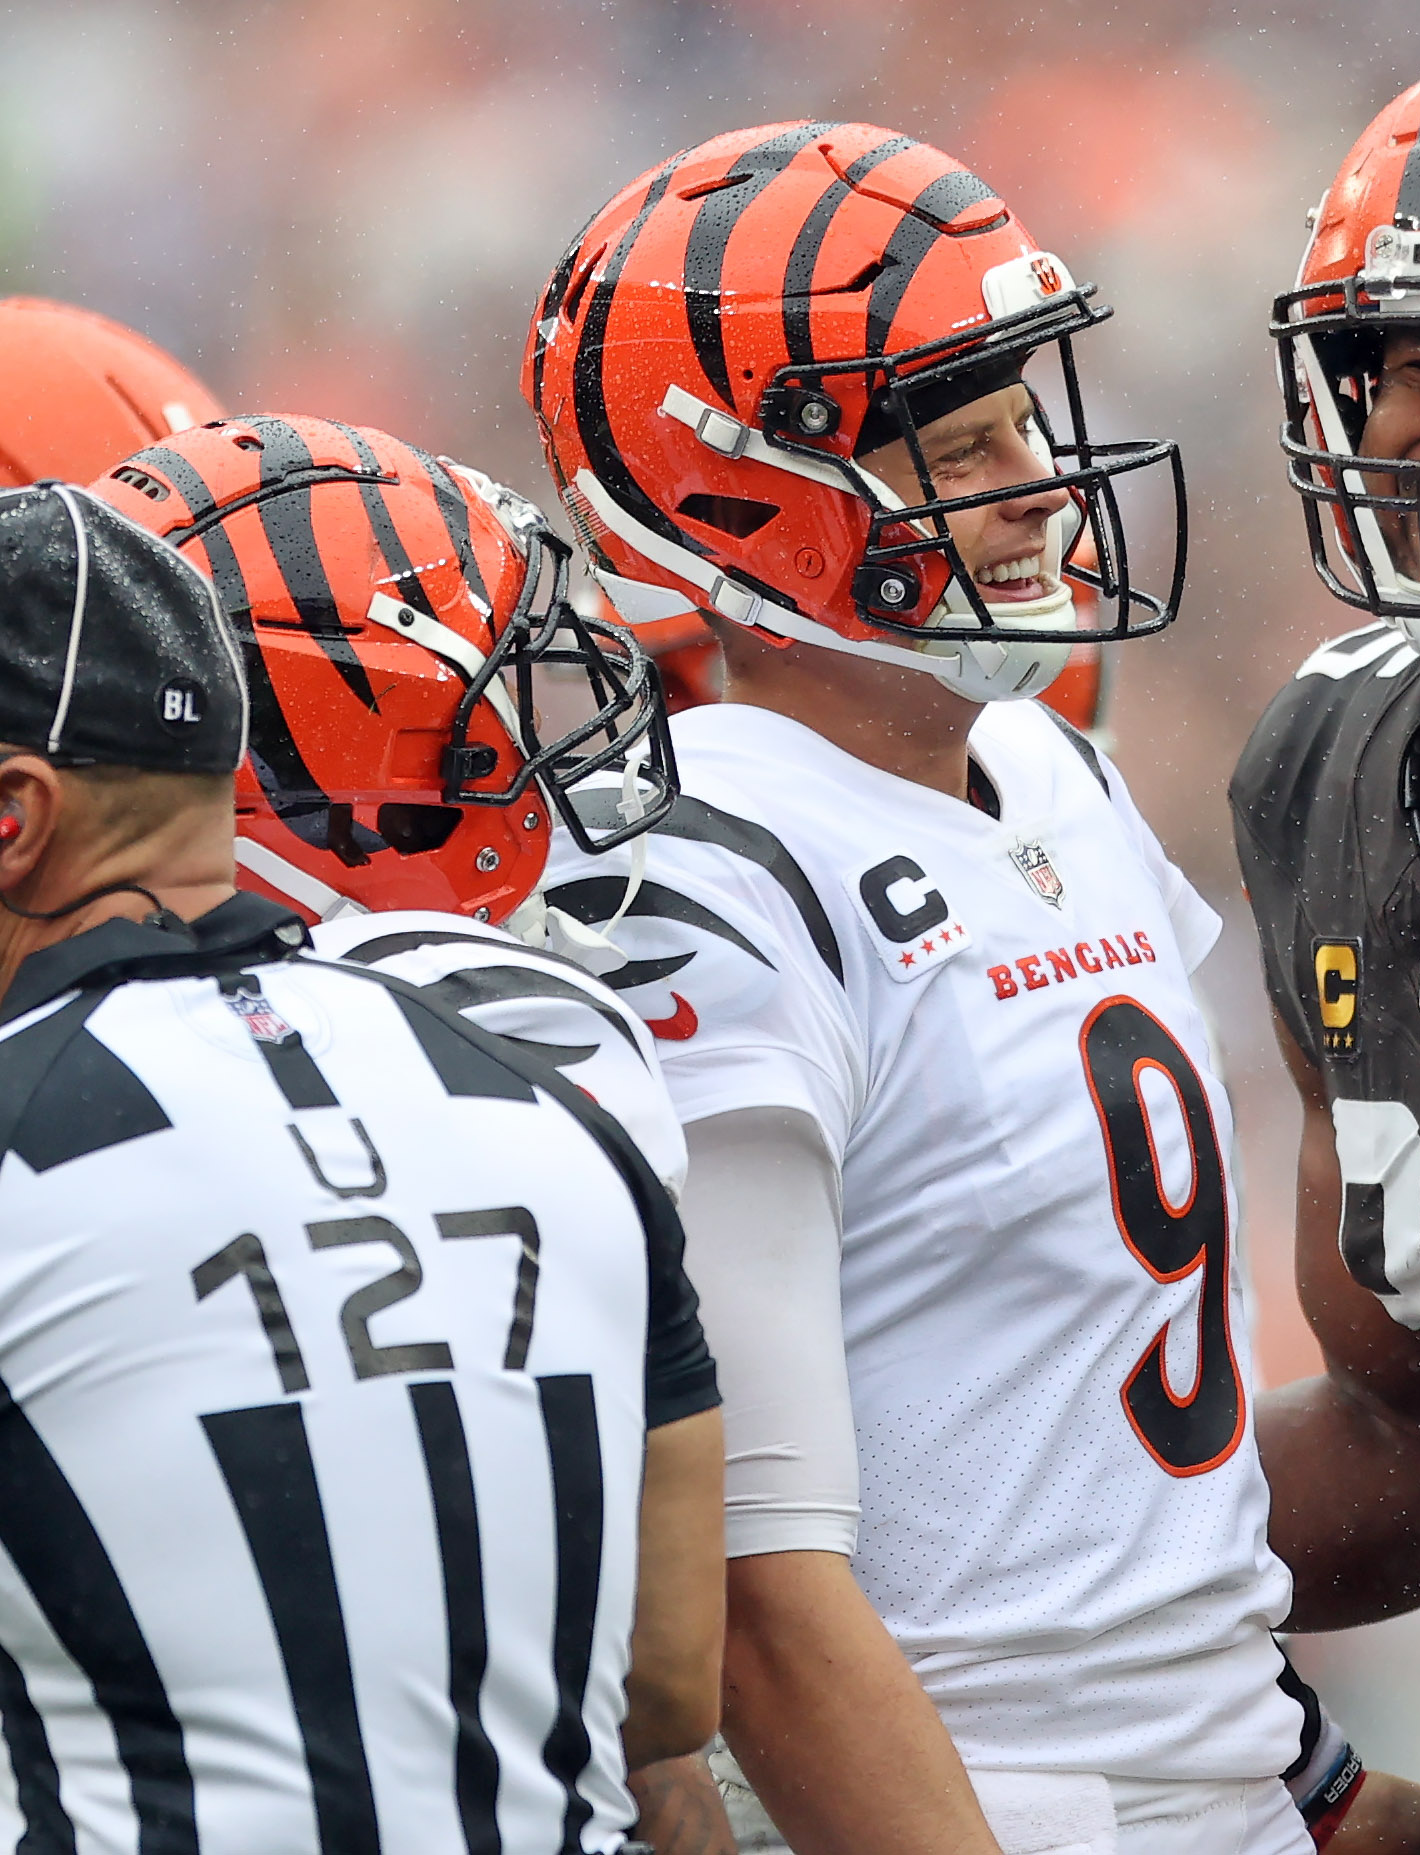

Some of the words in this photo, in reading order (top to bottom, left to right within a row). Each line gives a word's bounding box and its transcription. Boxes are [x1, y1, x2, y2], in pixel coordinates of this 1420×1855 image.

[164, 688, 201, 722] BL
[859, 855, 949, 944] C
[987, 931, 1156, 1001] BENGALS
[1315, 944, 1357, 1029] C
[286, 1117, 388, 1200] U
[1079, 994, 1247, 1479] 9
[191, 1206, 541, 1390] 127
